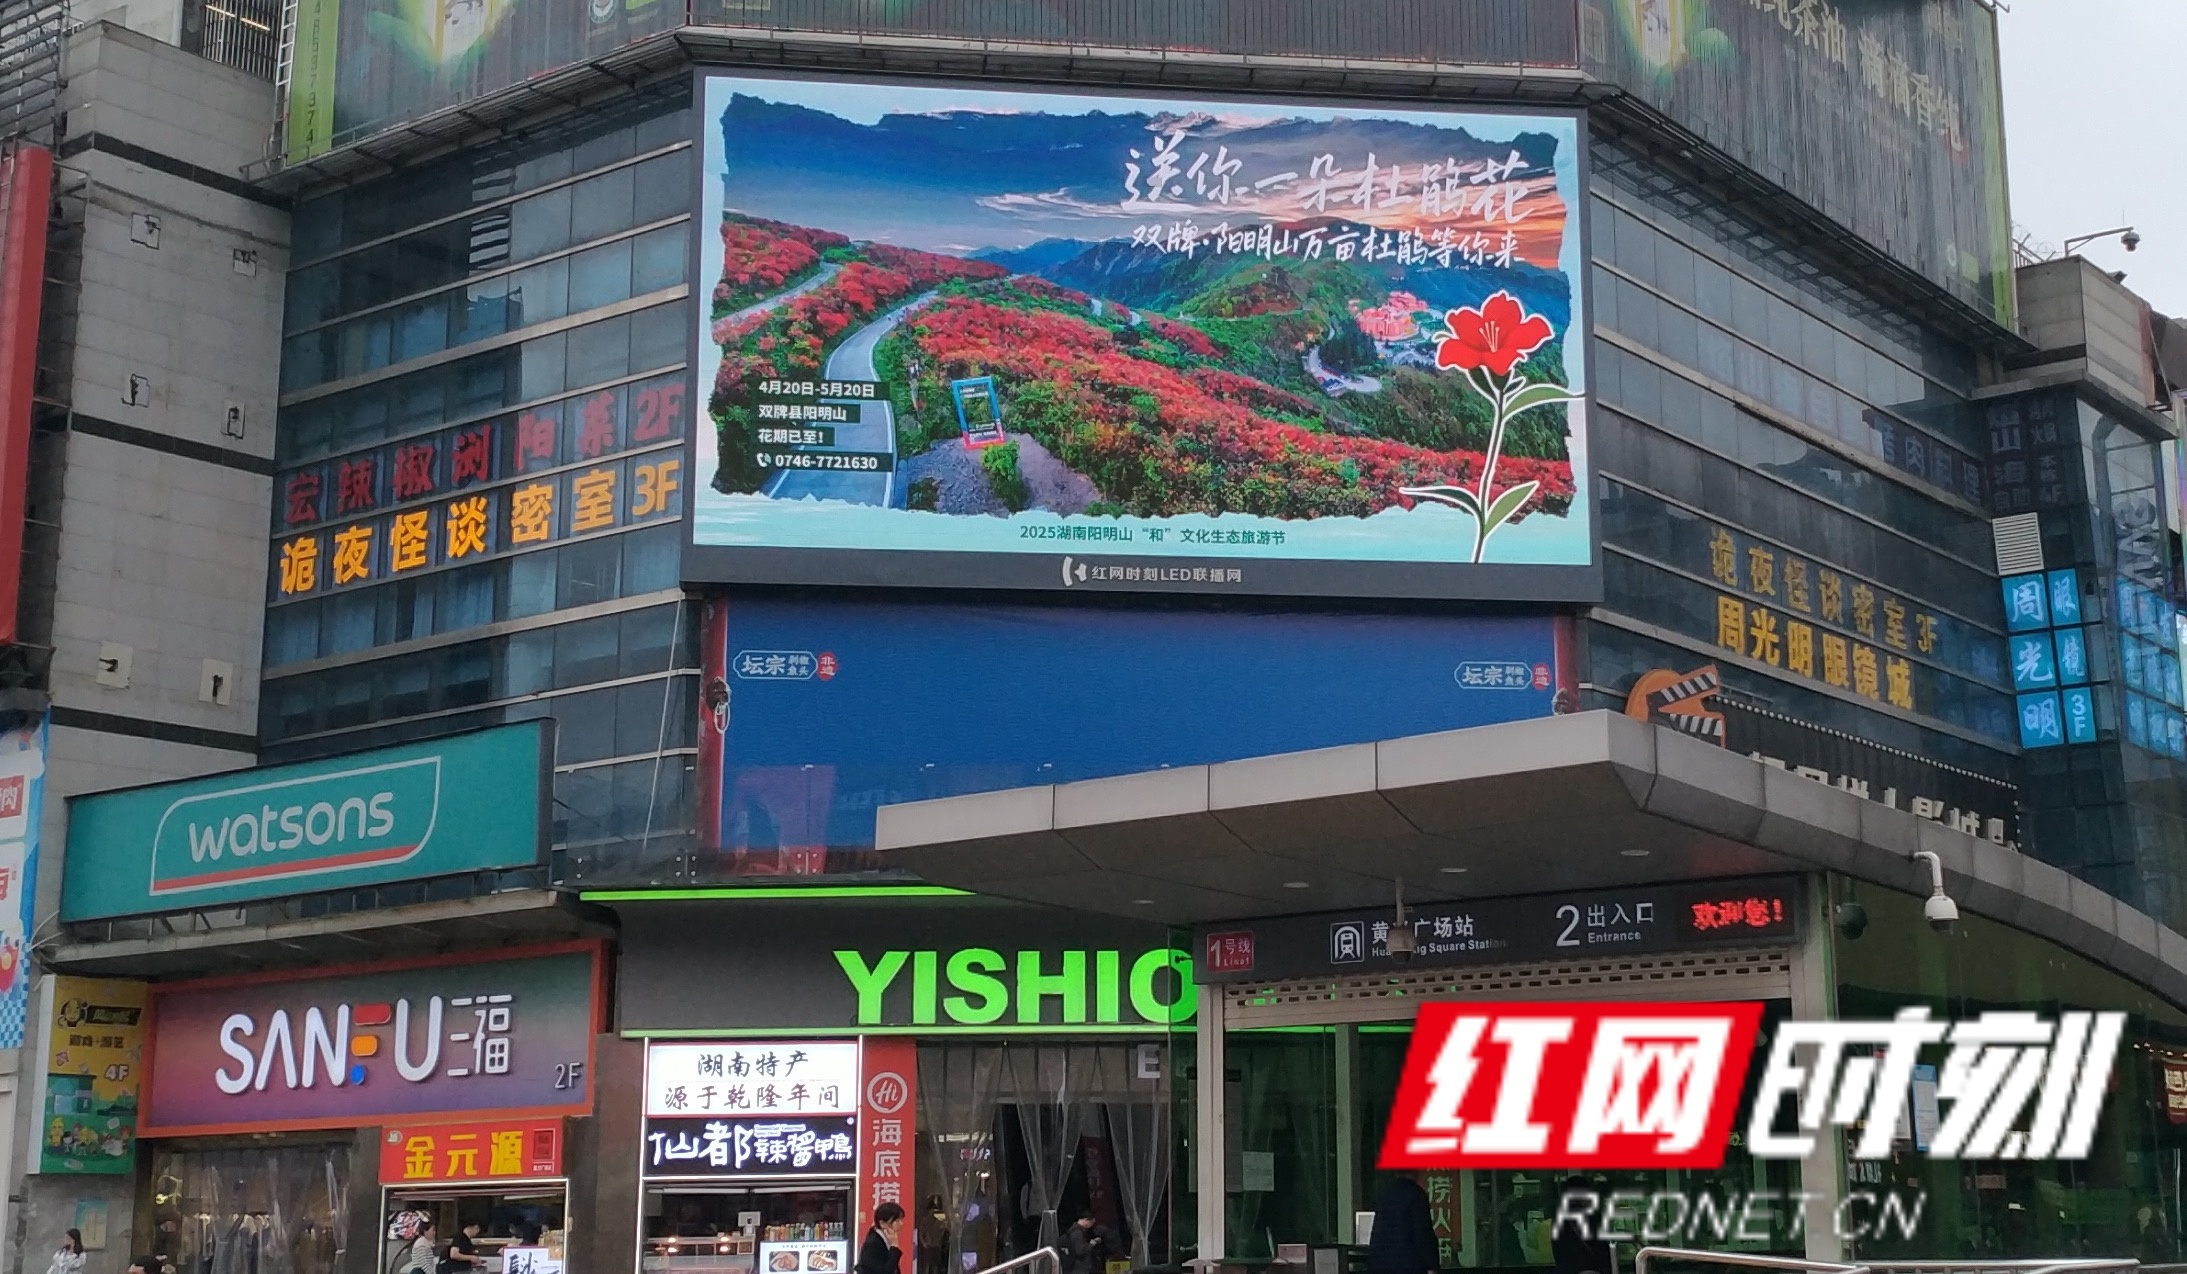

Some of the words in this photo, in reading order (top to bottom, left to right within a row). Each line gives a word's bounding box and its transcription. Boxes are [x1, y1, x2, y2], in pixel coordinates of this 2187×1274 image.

[1120, 129, 1534, 224] 送你一朵杜鹃花
[1131, 219, 1526, 269] 双牌·阳明山万亩杜鹃等你来
[758, 380, 876, 399] 4月20日-5月20日
[758, 404, 848, 422] 双牌县阳明山
[775, 453, 878, 470] 0746-7721630
[280, 460, 680, 594] 诡夜怪谈密室3F
[1091, 564, 1243, 584] 红网时刻LED联播网
[741, 655, 786, 676] 坛宗
[1717, 595, 1913, 710] 周光明眼镜城
[2012, 580, 2059, 739] 周光明
[2054, 576, 2085, 676] 眼镜
[2072, 694, 2086, 738] 3F
[1462, 665, 1503, 686] 坛宗
[188, 791, 395, 862] watsons
[1372, 914, 1475, 944] 黄广场站
[1556, 904, 1580, 947] 2
[1587, 903, 1654, 928] 出入口
[1588, 932, 1641, 943] Entrance
[1210, 940, 1221, 967] 1
[1224, 938, 1251, 956] 号线
[1428, 942, 1466, 954] Square
[447, 994, 513, 1075] 三福
[105, 1064, 130, 1081] 4F
[555, 1062, 582, 1089] 2F
[697, 1050, 809, 1078] 湖南特产
[664, 1083, 840, 1111] 源于乾隆年间
[403, 1131, 524, 1179] 金元源
